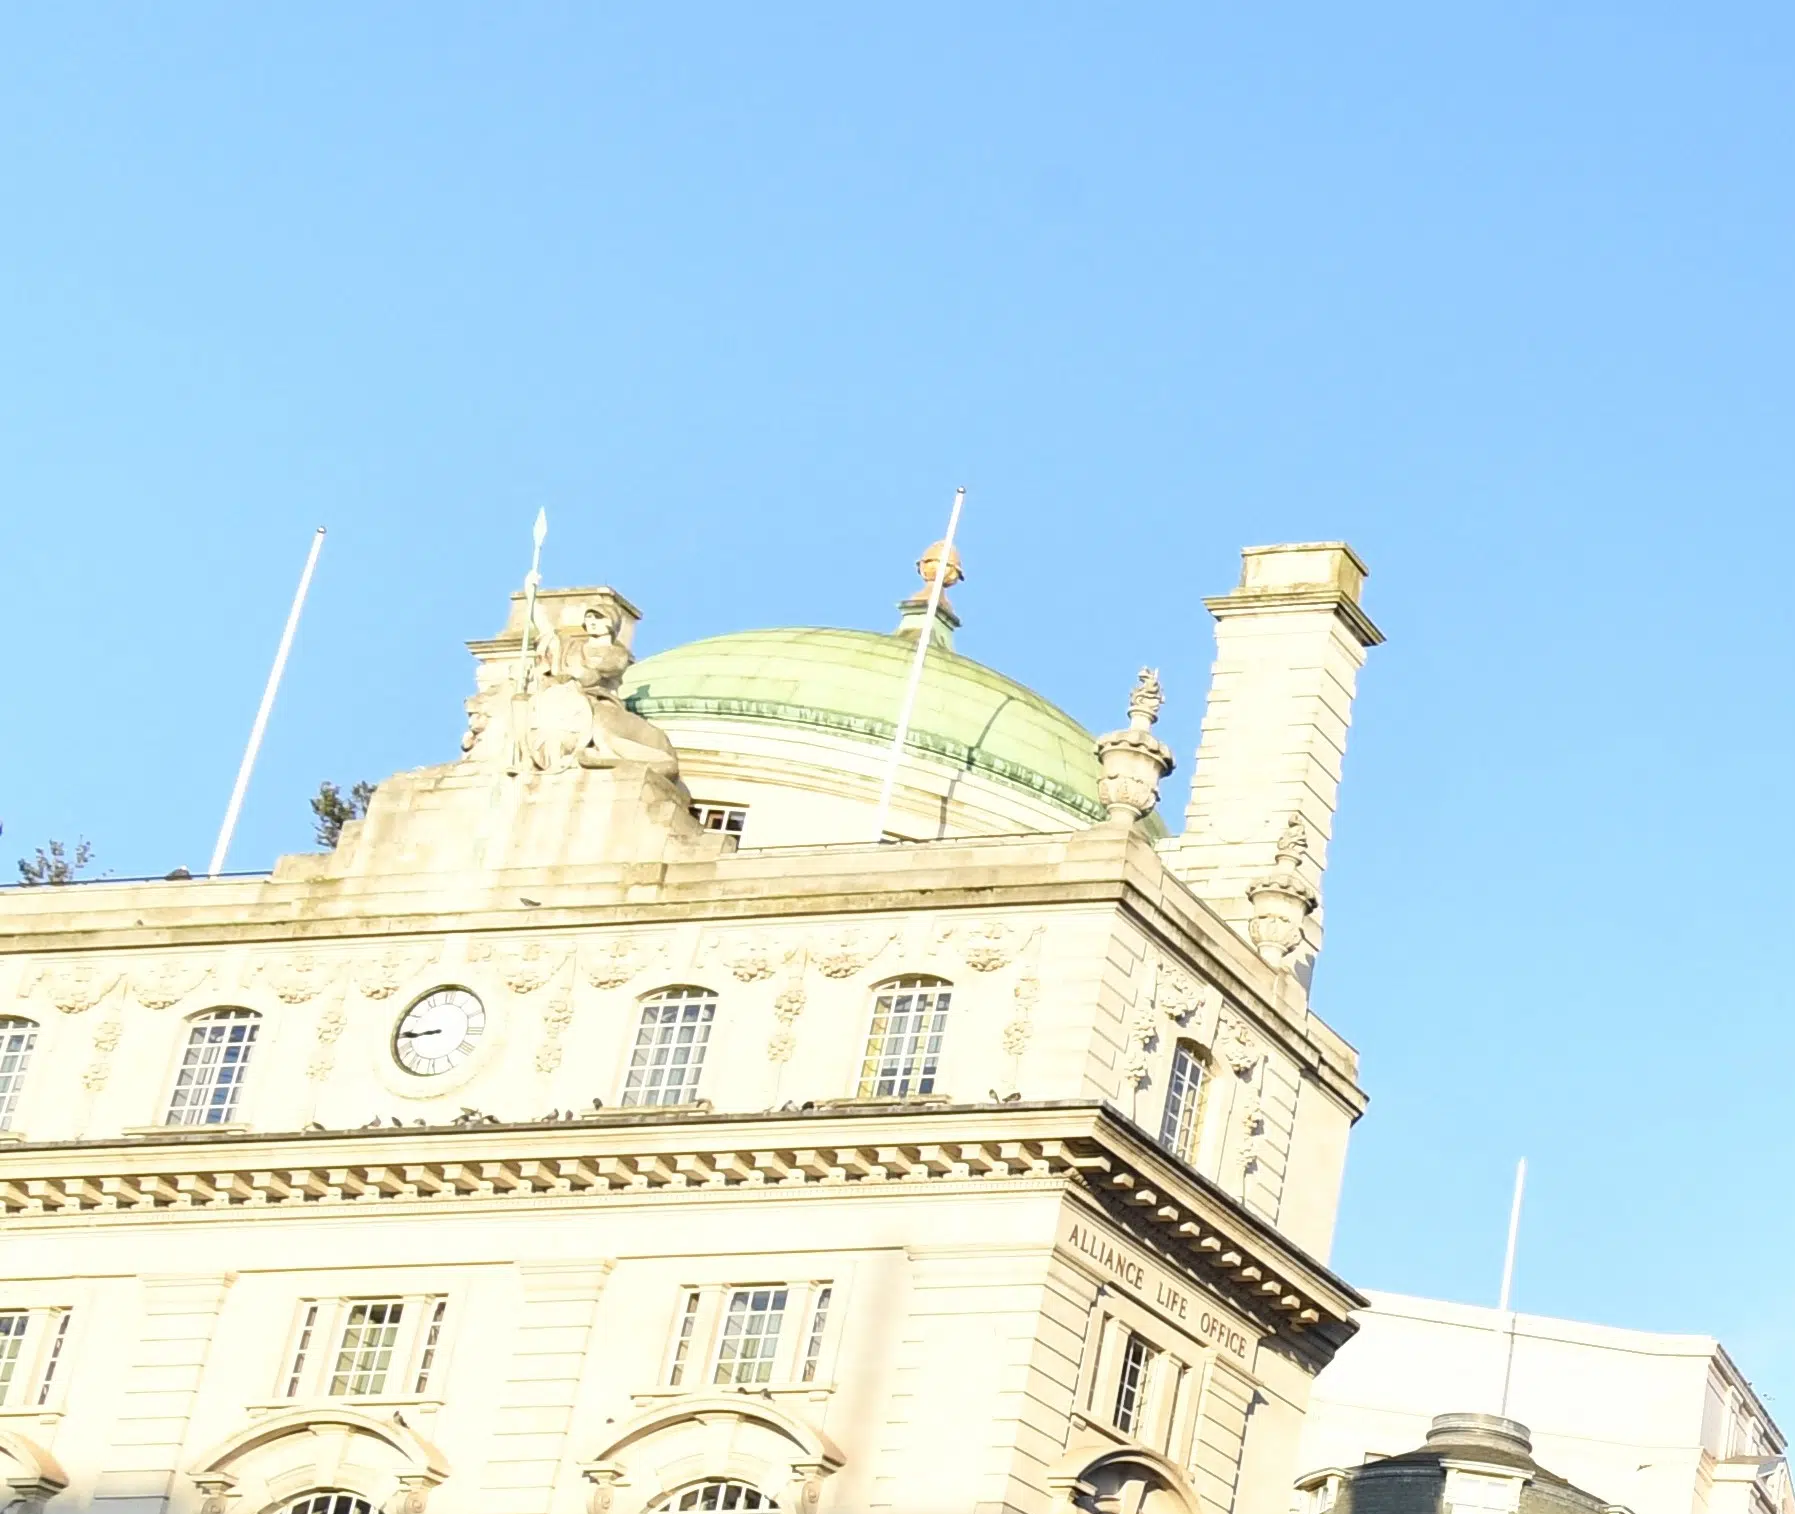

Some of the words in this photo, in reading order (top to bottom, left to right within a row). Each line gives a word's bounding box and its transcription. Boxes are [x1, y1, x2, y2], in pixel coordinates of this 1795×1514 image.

[1068, 1224, 1145, 1290] ALLIANCE
[1156, 1281, 1189, 1320] LIFE
[1200, 1312, 1248, 1359] OFFICE
